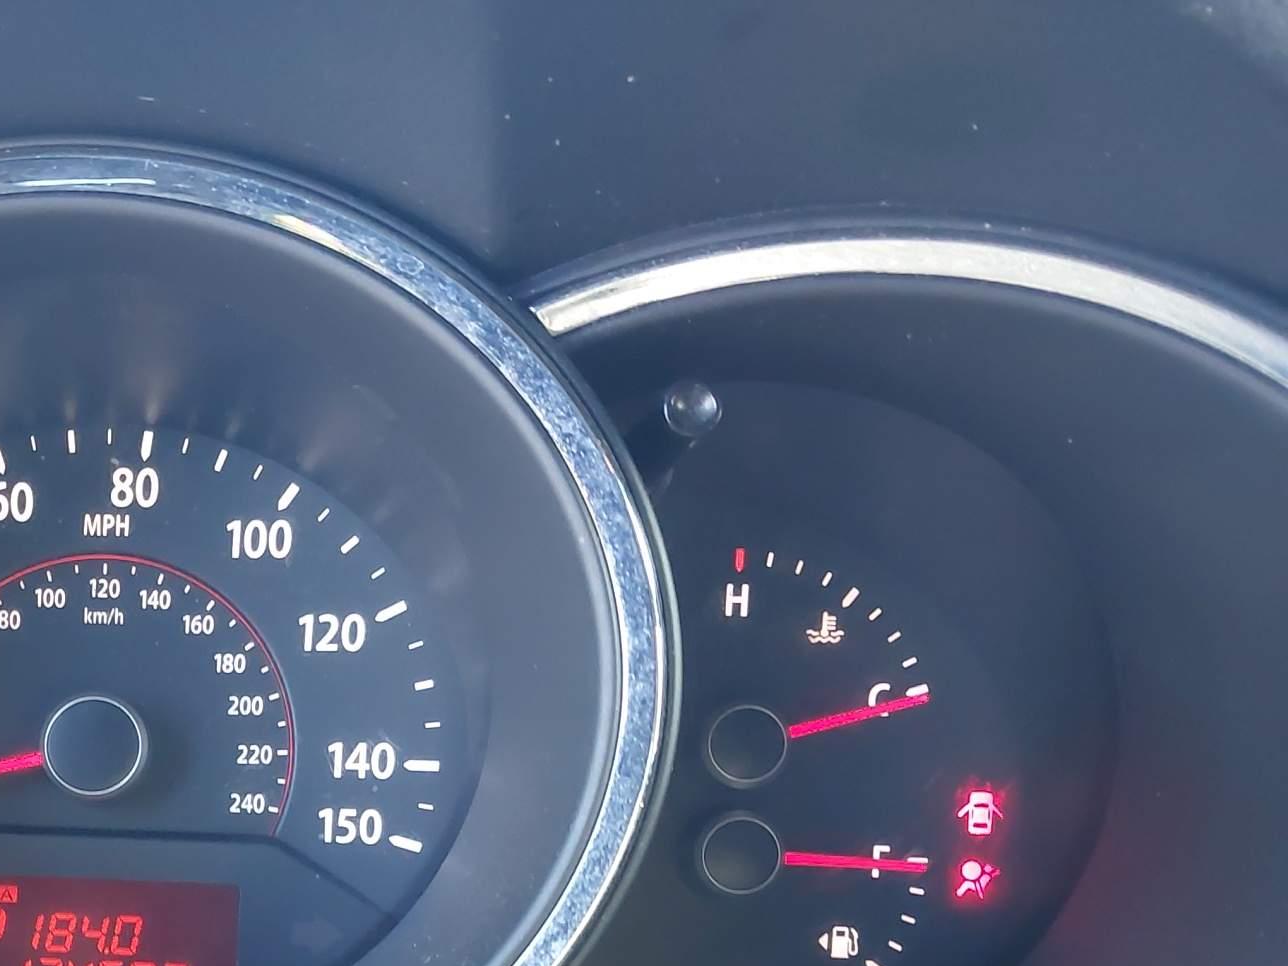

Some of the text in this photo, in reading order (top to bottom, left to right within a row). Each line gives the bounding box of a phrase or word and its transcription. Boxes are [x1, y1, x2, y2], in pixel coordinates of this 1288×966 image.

[110, 467, 160, 508] 80
[83, 513, 130, 537] MPH
[225, 519, 293, 559] 100
[34, 588, 66, 609] 100
[88, 578, 121, 599] 120
[139, 589, 171, 610] 140
[724, 583, 750, 617] H
[83, 607, 124, 627] km/h
[182, 614, 215, 636] 160
[298, 613, 366, 652] 120
[214, 653, 246, 674] 180
[227, 695, 263, 716] 200
[236, 744, 273, 765] 220
[327, 741, 396, 780] 140
[229, 793, 266, 814] 240
[318, 807, 383, 846] 150
[31, 911, 144, 956] 184.0
